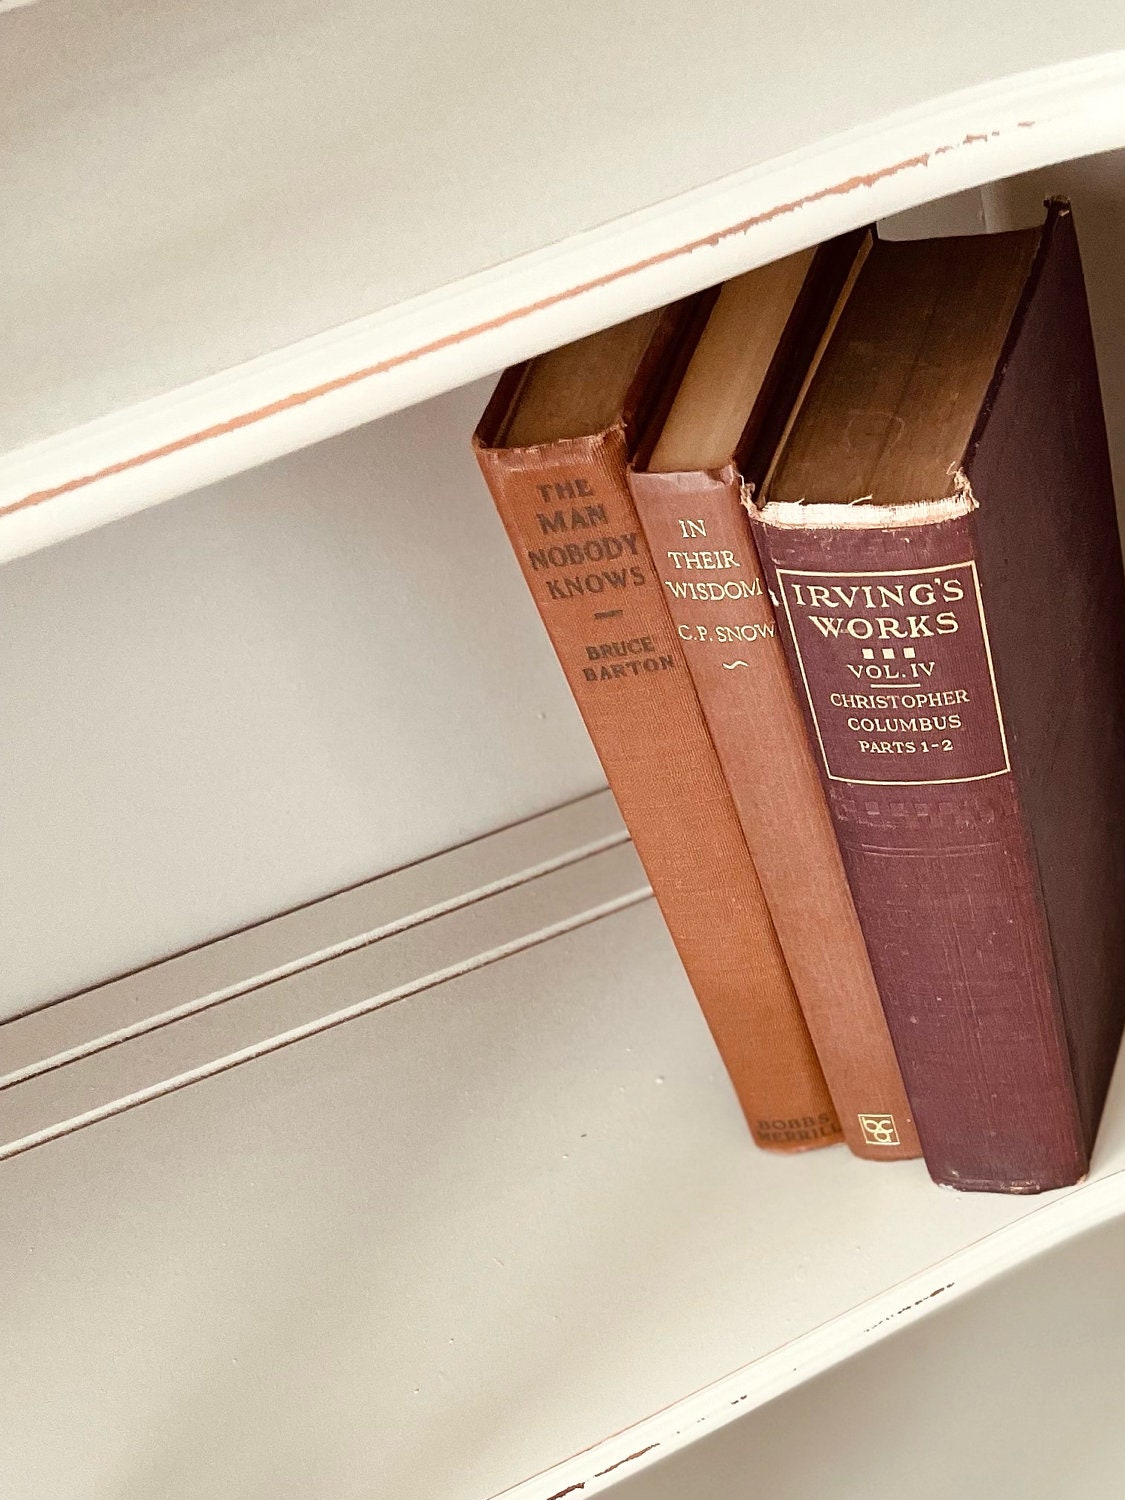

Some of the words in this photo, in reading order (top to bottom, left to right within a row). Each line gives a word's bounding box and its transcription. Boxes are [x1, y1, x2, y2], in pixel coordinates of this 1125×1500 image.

[536, 478, 594, 502] THE
[536, 504, 608, 535] MAN
[678, 519, 707, 538] IN
[527, 533, 640, 571] NOBODY
[668, 550, 740, 570] THEIR
[546, 566, 646, 600] KNOWS
[665, 578, 763, 601] WISDOM
[791, 578, 965, 609] IRVING'S
[808, 612, 960, 640] WORKS
[585, 635, 656, 661] BRUCE
[582, 655, 675, 682] BARTON
[847, 664, 906, 679] VOL.
[911, 662, 935, 677] IV
[830, 690, 970, 708] CHRISTOPHER
[847, 715, 962, 732] COLUMBUS
[859, 740, 917, 754] PARTS
